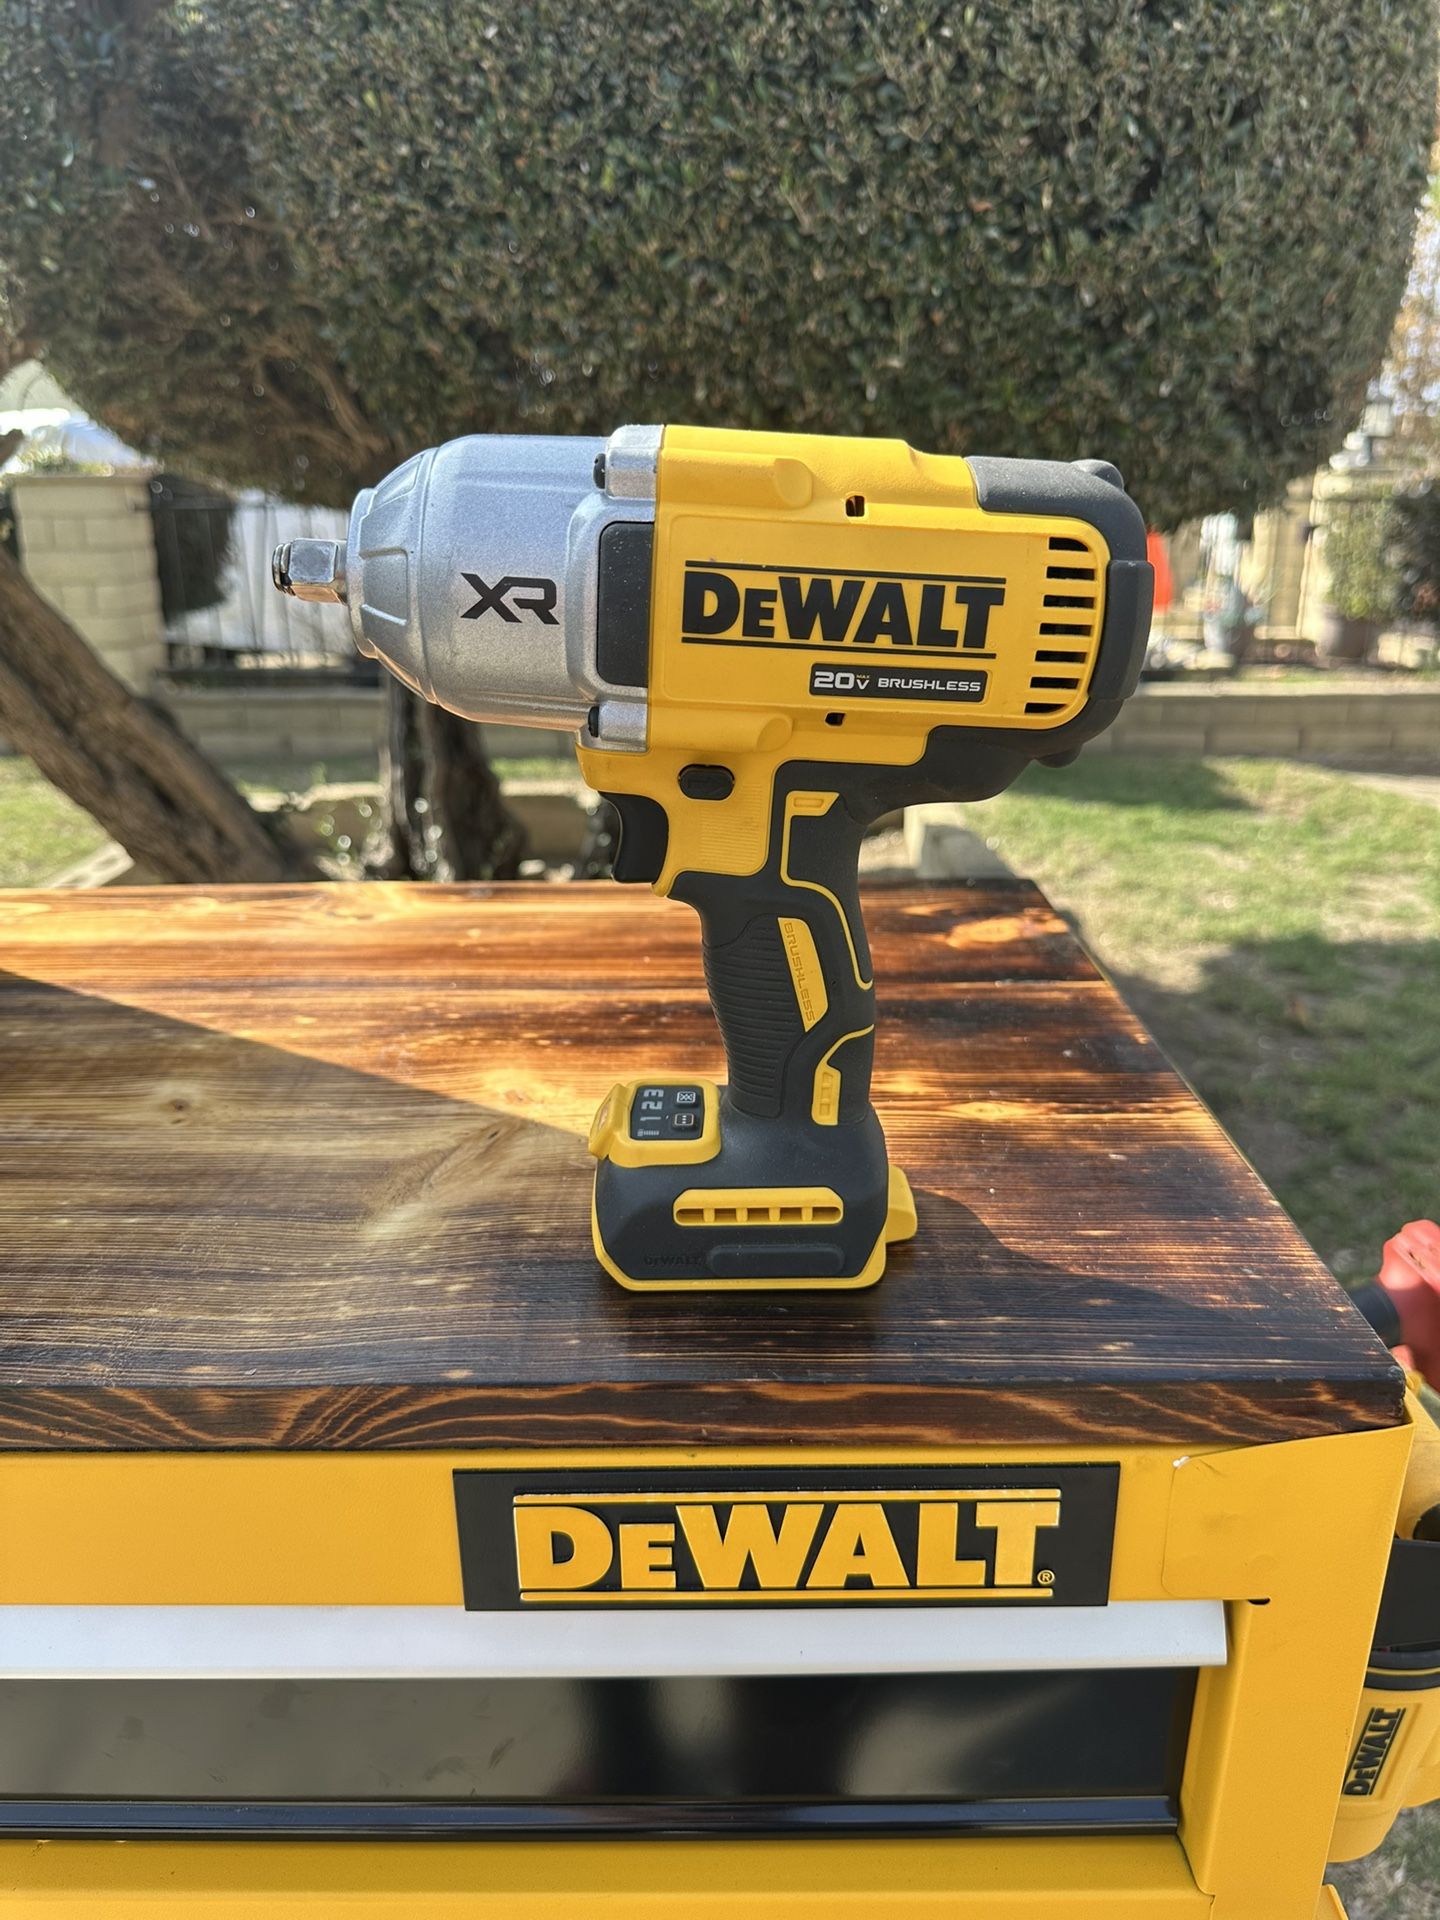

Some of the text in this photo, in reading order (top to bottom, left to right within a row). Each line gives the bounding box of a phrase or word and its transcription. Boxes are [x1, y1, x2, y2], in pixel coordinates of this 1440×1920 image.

[460, 572, 560, 625] XR
[682, 570, 1006, 649] DEWALT
[877, 678, 981, 692] BRUSHLESS
[784, 922, 816, 1022] BRUSHLESS
[1343, 1708, 1401, 1796] DEWALT
